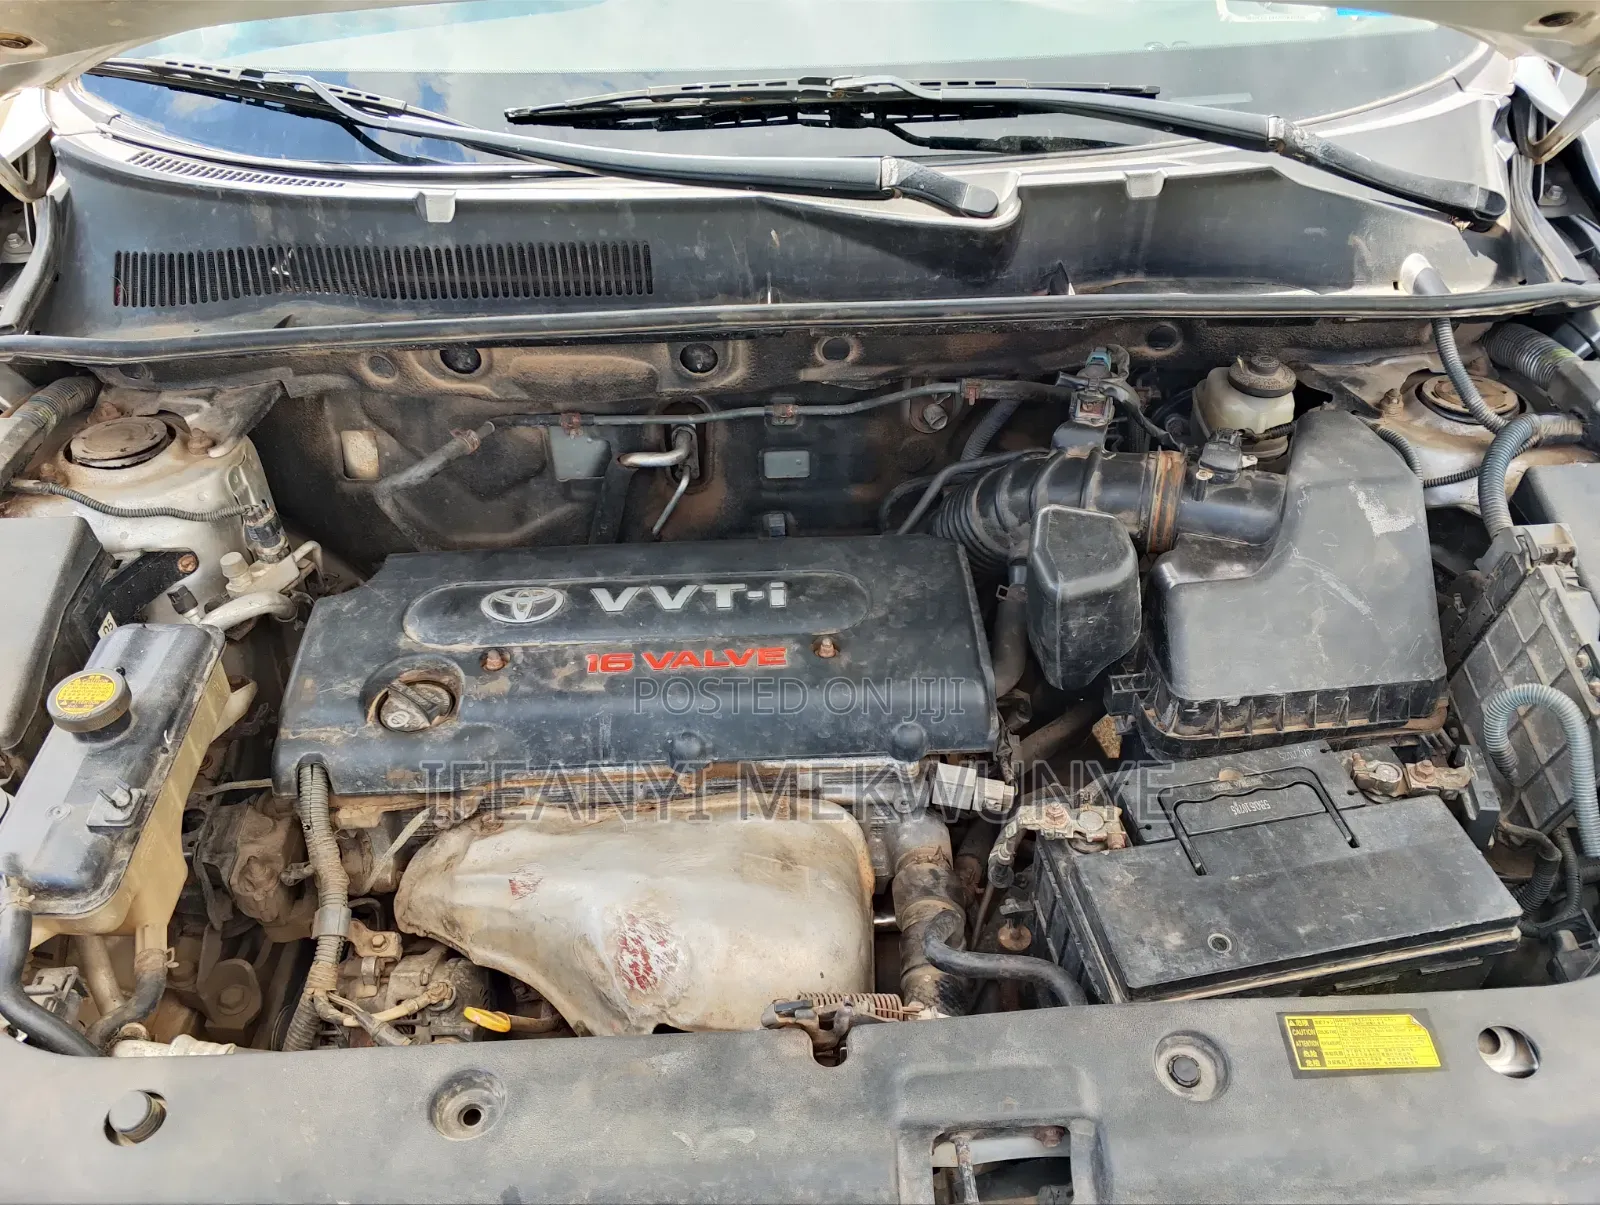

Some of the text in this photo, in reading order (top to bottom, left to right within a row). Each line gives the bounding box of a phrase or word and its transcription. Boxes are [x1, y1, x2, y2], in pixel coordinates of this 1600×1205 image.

[590, 582, 787, 614] VVT-i
[585, 647, 788, 674] 16 VALVE
[1292, 1028, 1317, 1036] CAUTION
[1295, 1039, 1320, 1048] ATTENTION
